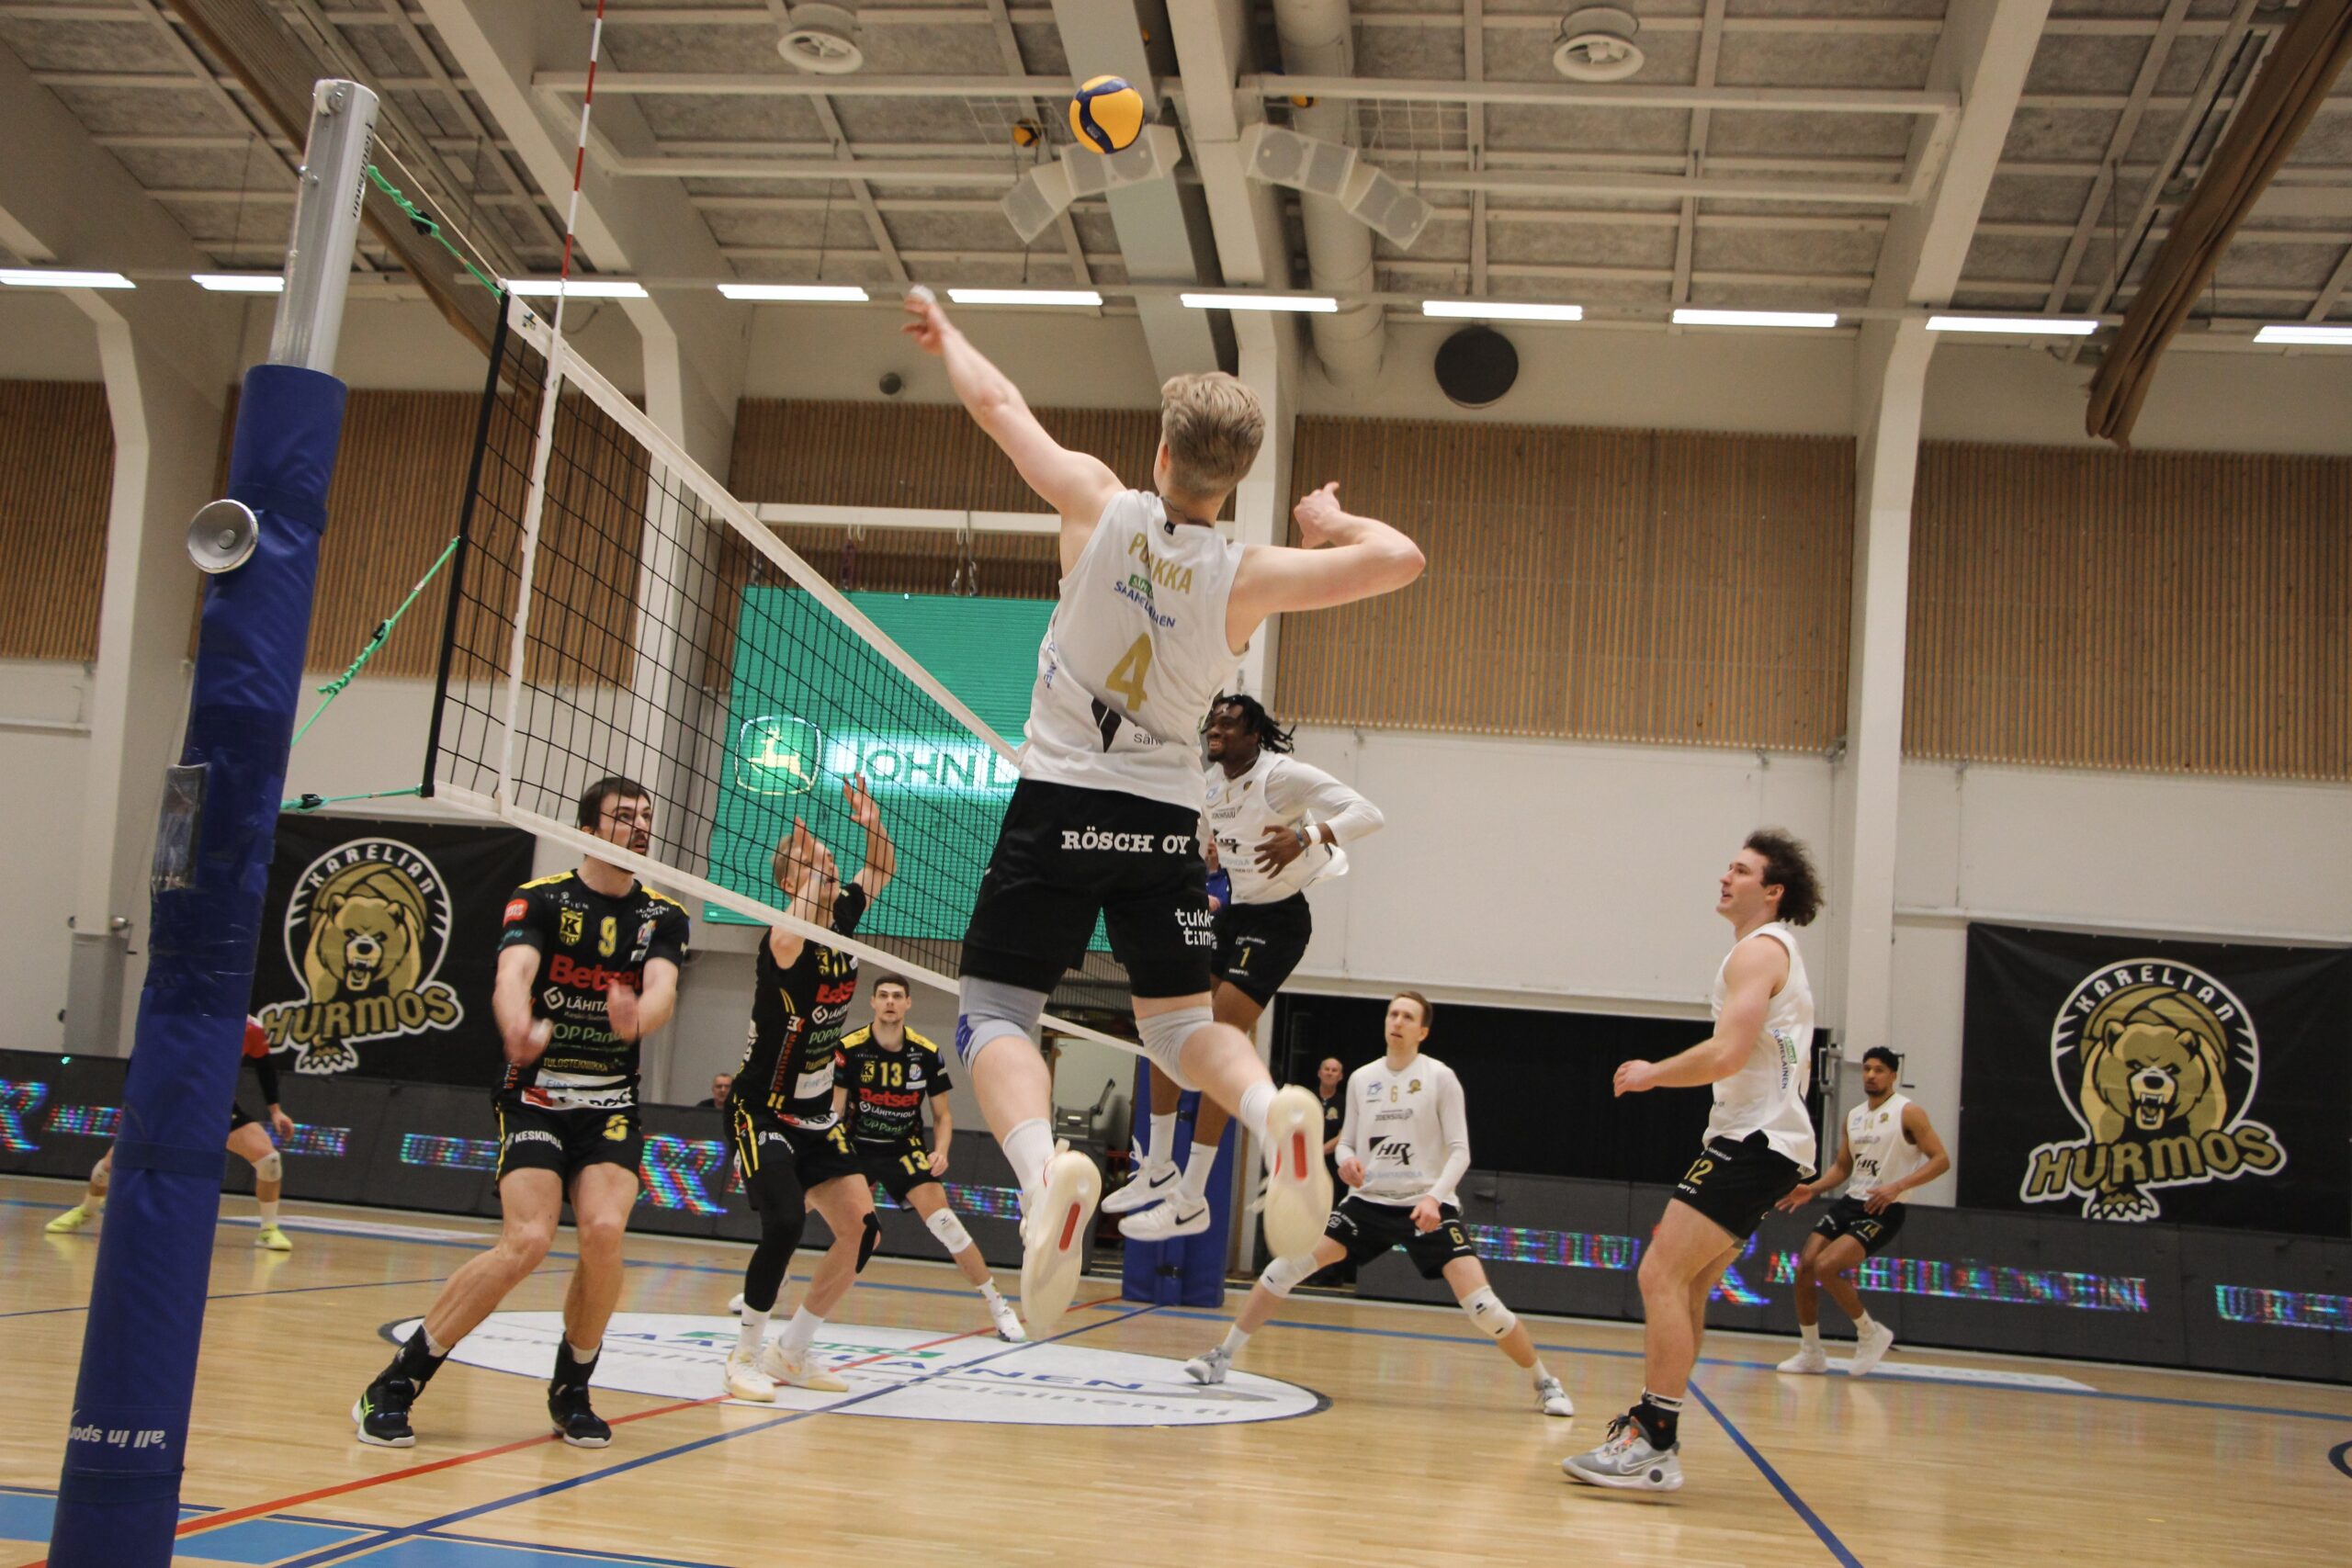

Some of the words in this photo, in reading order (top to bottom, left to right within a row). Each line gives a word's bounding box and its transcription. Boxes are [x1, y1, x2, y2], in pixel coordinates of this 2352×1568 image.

[1105, 631, 1153, 712] 4
[843, 739, 978, 788] JOHN
[1061, 825, 1154, 853] RÖSCH
[1162, 834, 1191, 854] OY
[308, 843, 435, 896] KARELIAN
[598, 916, 616, 957] 9
[1239, 946, 1251, 967] 1
[2075, 964, 2235, 1021] KARELIAN
[264, 986, 460, 1047] HURMOS
[880, 1061, 903, 1087] 13
[859, 1087, 920, 1108] Betset
[899, 1150, 933, 1176] 13
[1683, 1157, 1713, 1186] 12
[2025, 1125, 2278, 1196] HURMOS
[1448, 1226, 1464, 1246] 6
[70, 1424, 103, 1443] spor
[107, 1429, 130, 1449] in
[133, 1429, 165, 1449] all
